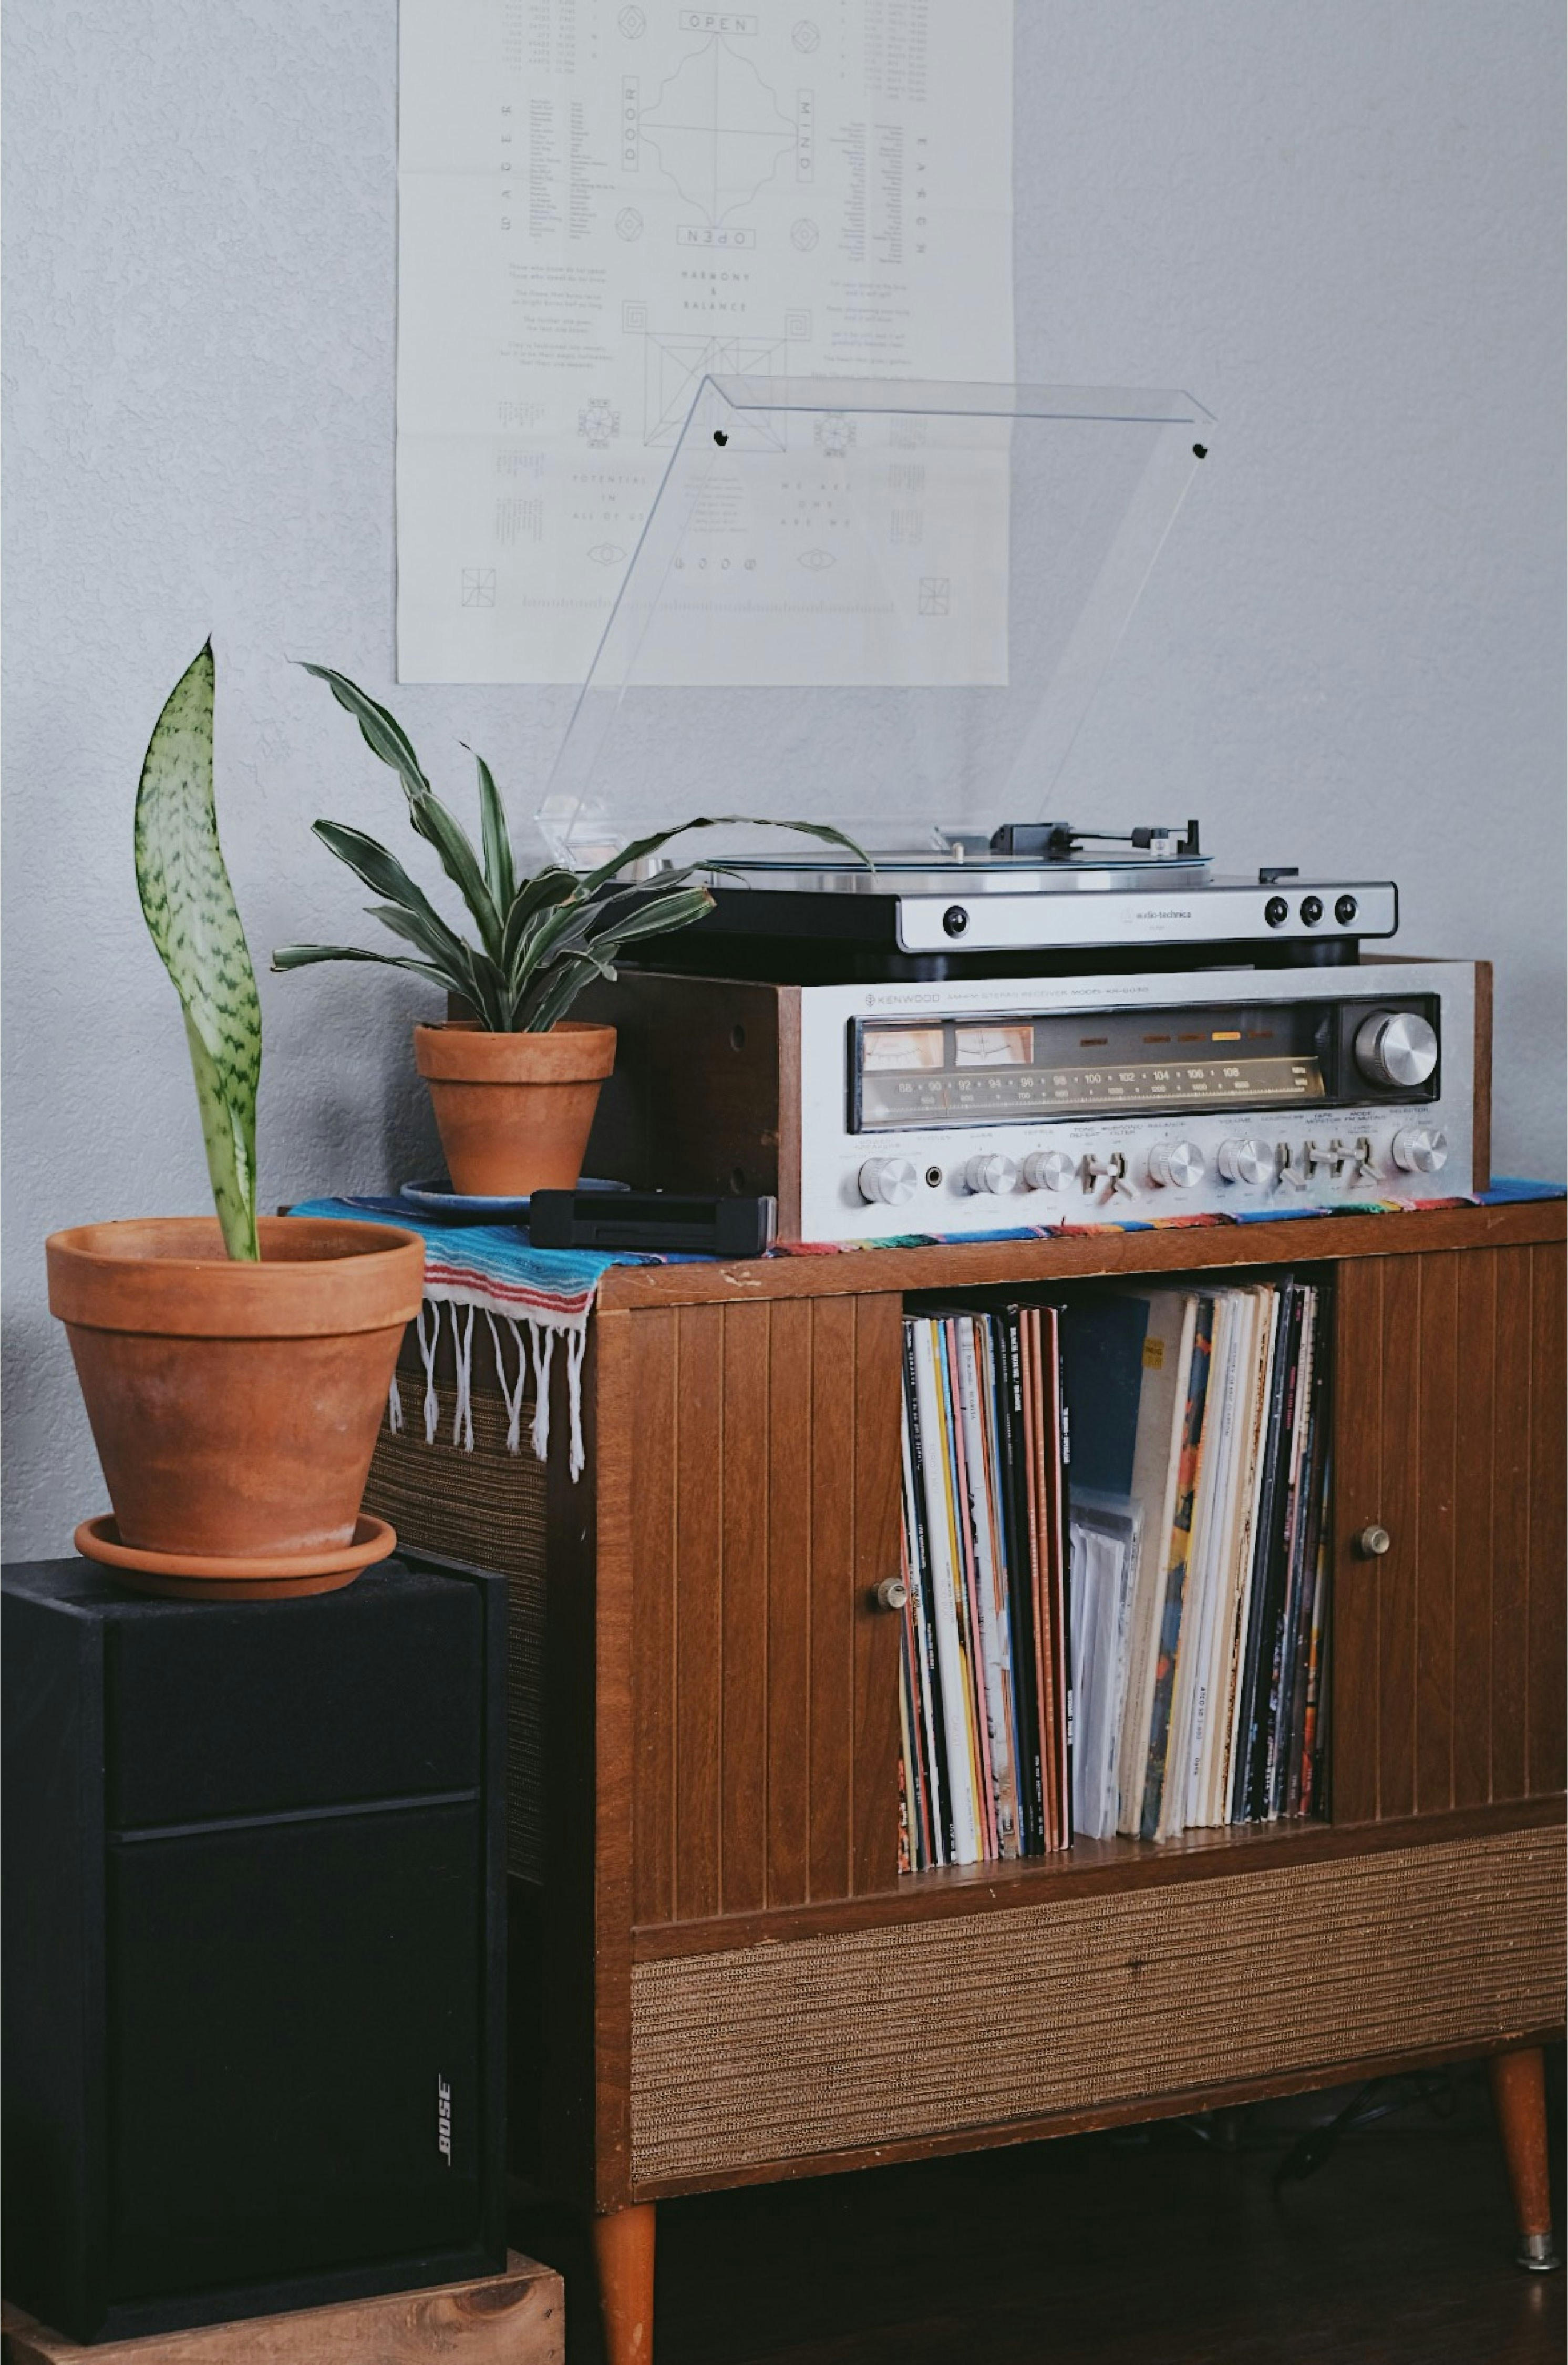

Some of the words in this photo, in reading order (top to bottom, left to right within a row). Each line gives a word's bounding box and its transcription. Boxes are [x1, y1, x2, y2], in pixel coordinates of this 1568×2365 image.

[688, 16, 747, 32] OPEN
[625, 89, 635, 161] DOOR
[799, 102, 811, 169] MIND
[688, 230, 746, 245] OPEN
[682, 271, 750, 282] HARMONY
[684, 301, 747, 312] BALANCE
[878, 994, 940, 1004] KENWOOD
[899, 1083, 912, 1092] 88
[929, 1081, 941, 1091] 90
[958, 1079, 971, 1089] 92
[988, 1078, 1000, 1088] 94
[1020, 1077, 1033, 1087] 96
[1085, 1073, 1101, 1084] 100
[1119, 1073, 1134, 1082] 102
[1153, 1071, 1169, 1081] 104
[1188, 1069, 1203, 1078] 106
[1223, 1067, 1240, 1077] 108
[439, 2073, 450, 2167] BOSE
